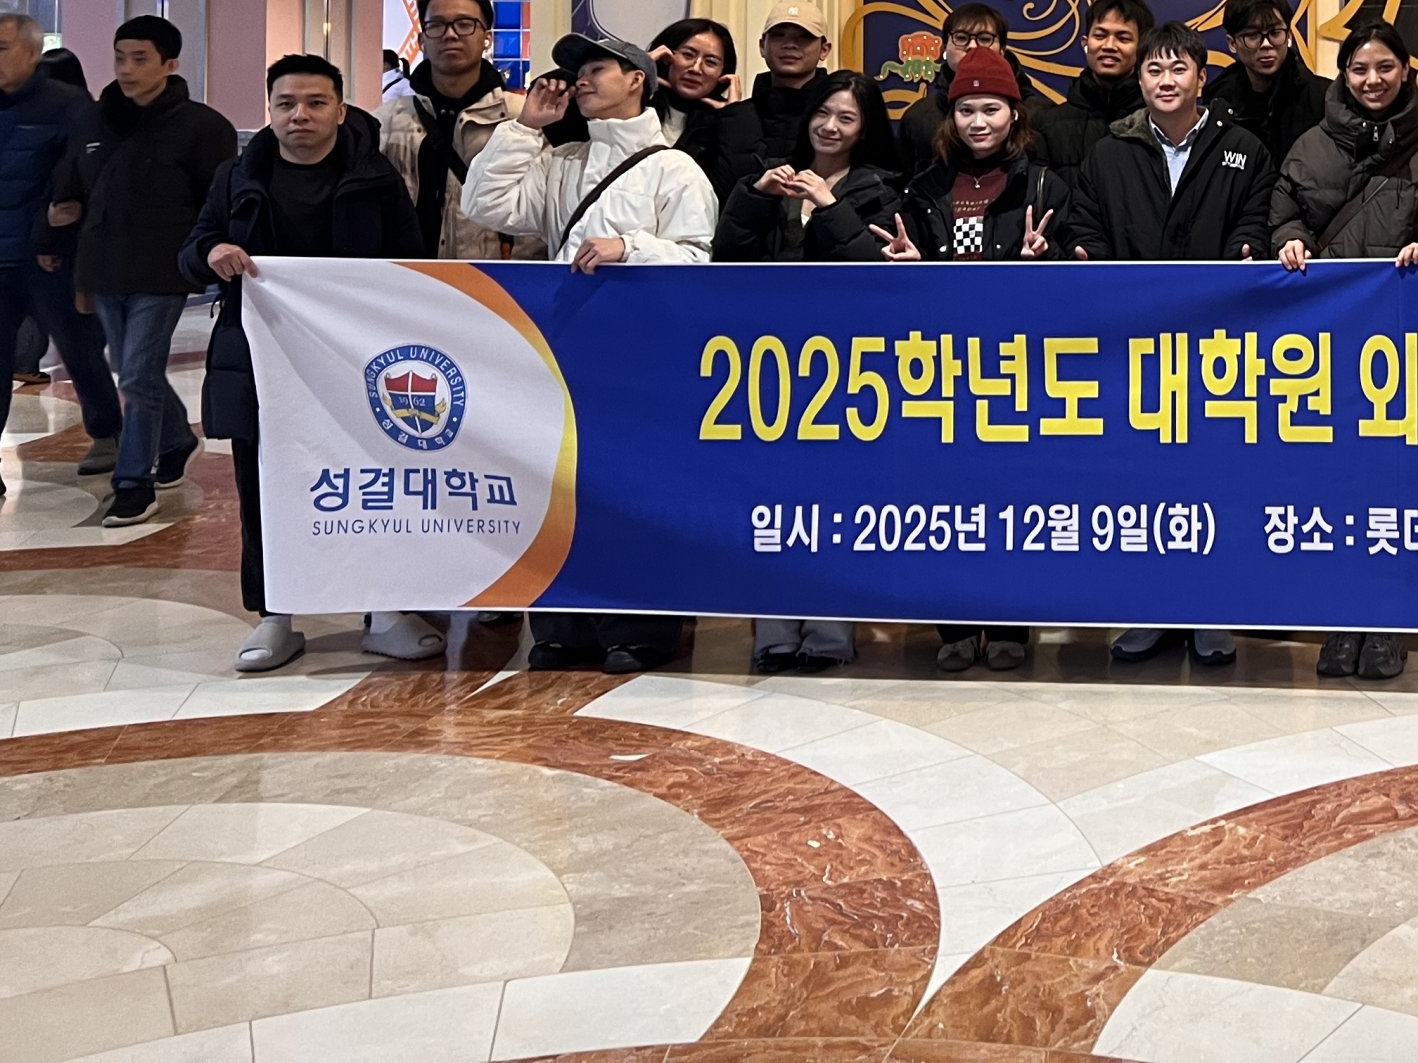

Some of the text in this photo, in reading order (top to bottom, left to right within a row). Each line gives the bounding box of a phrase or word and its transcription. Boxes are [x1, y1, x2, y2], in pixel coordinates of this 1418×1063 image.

[1224, 150, 1247, 166] WIN
[410, 347, 464, 407] UNIVERSITY
[699, 330, 1104, 444] 2025학년도
[1128, 328, 1334, 444] 대학원
[310, 468, 518, 513] 성결대학교
[312, 518, 521, 536] SUNGKYUL UNIVERSITY
[853, 503, 986, 552] 2025년
[998, 503, 1080, 552] 12월
[1091, 502, 1216, 555] 9일(화)
